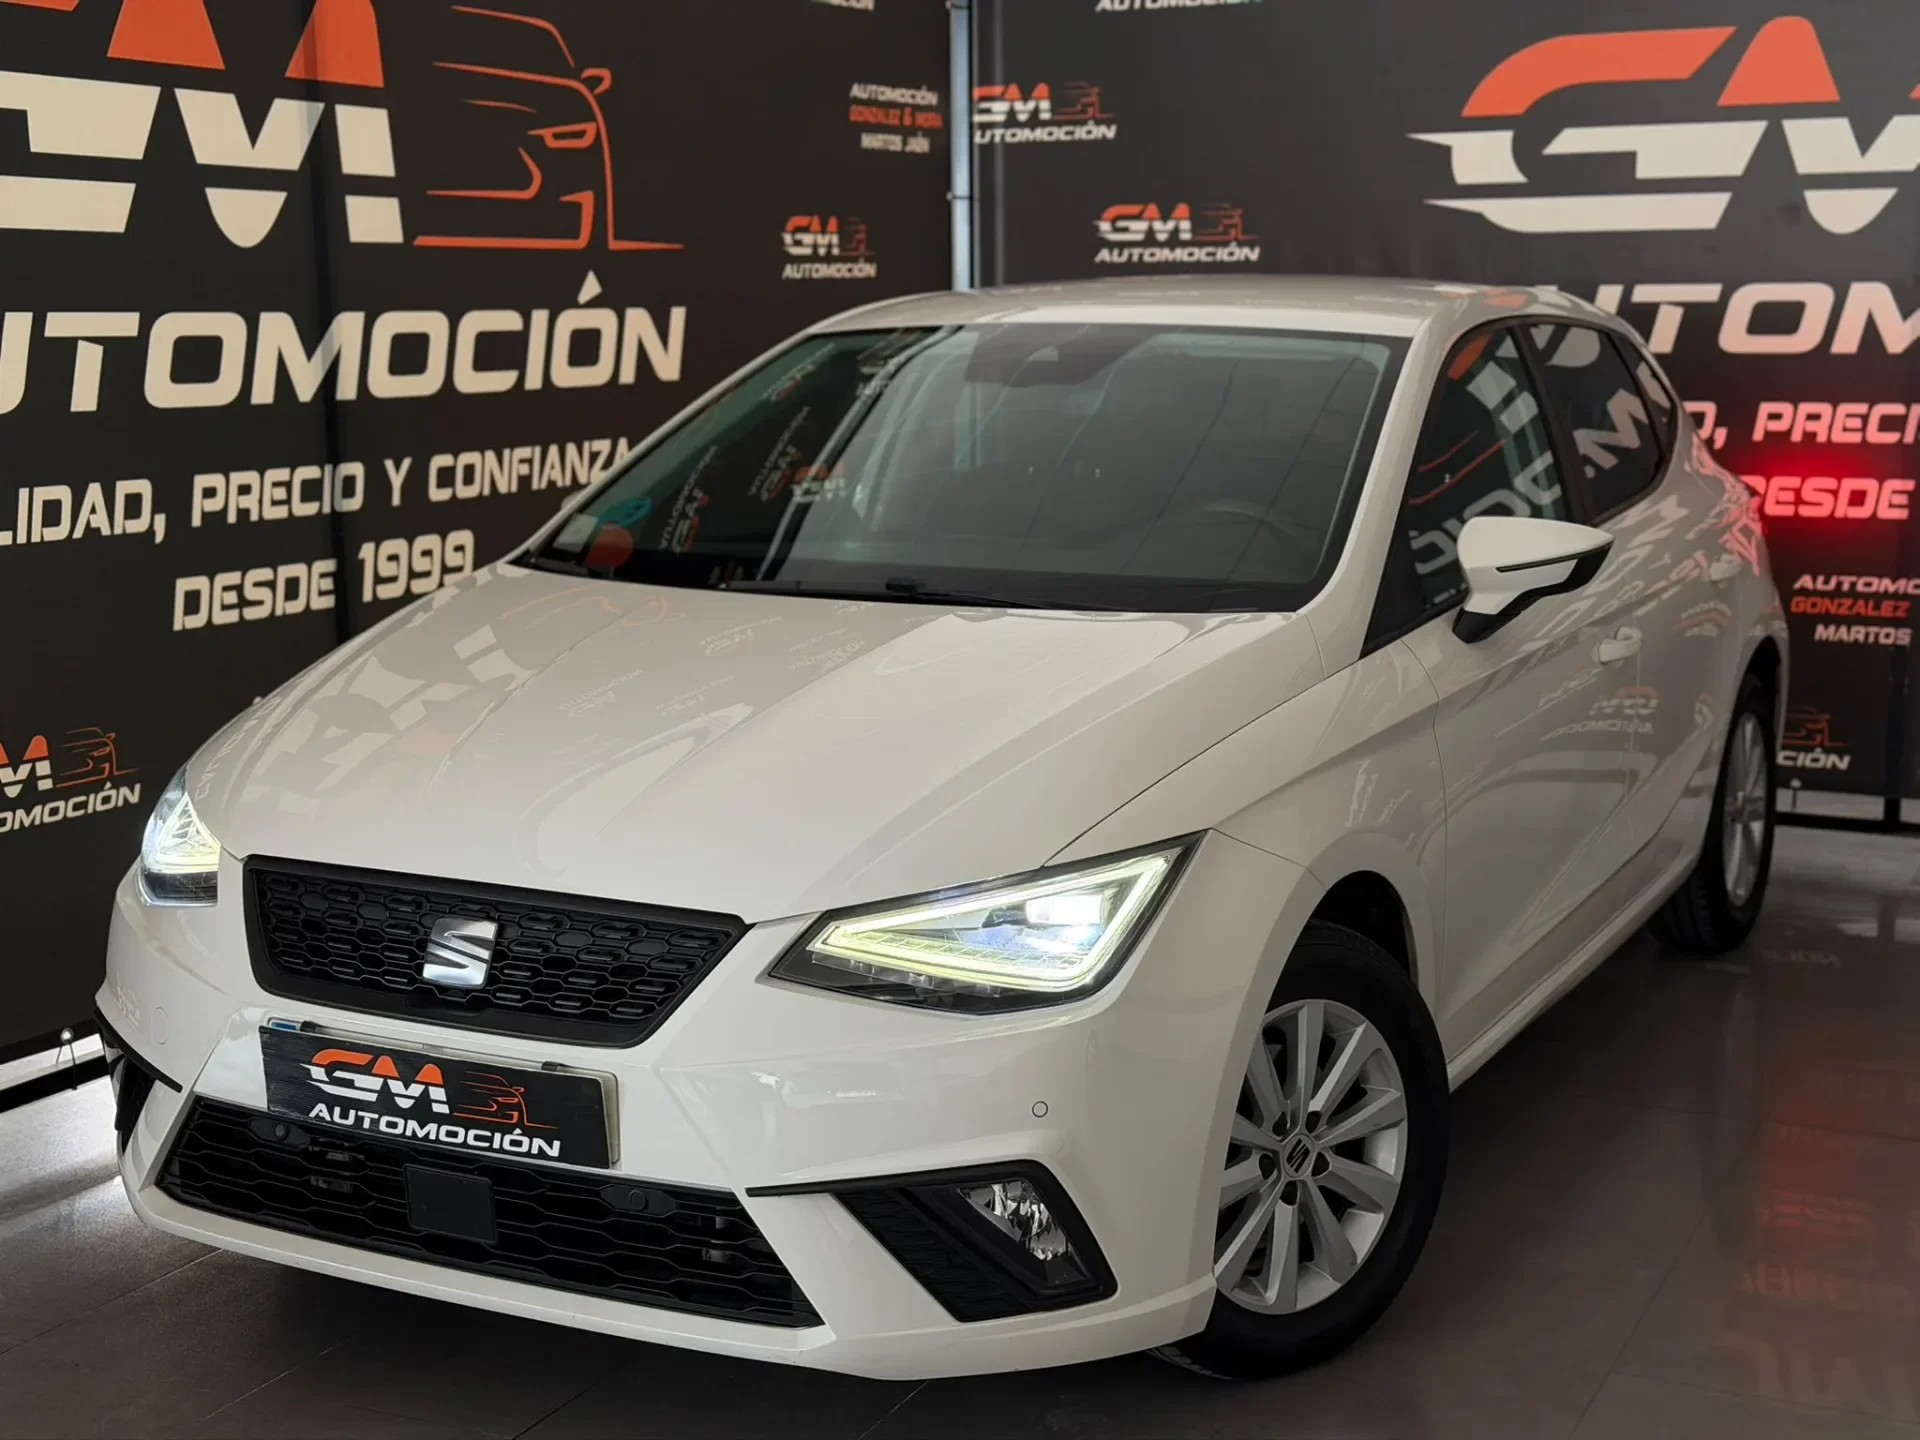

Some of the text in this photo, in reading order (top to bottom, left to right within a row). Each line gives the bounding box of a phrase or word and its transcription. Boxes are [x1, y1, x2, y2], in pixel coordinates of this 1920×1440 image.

[780, 214, 841, 256] GM
[1093, 202, 1193, 242] GM
[781, 257, 878, 280] AUTOMOCIÓN
[1094, 241, 1261, 264] AUTOMOCIÓN
[1752, 401, 1920, 445] PRECI
[191, 461, 365, 527] PRECIO
[384, 457, 413, 507] Y
[428, 437, 630, 502] CONFIANZA
[173, 529, 475, 631] DESDE 1999
[1790, 595, 1912, 618] GONZALEZ
[1814, 623, 1913, 647] MARTOS
[300, 1048, 450, 1115] GM
[308, 1103, 561, 1158] AUTOMOCIÓN
